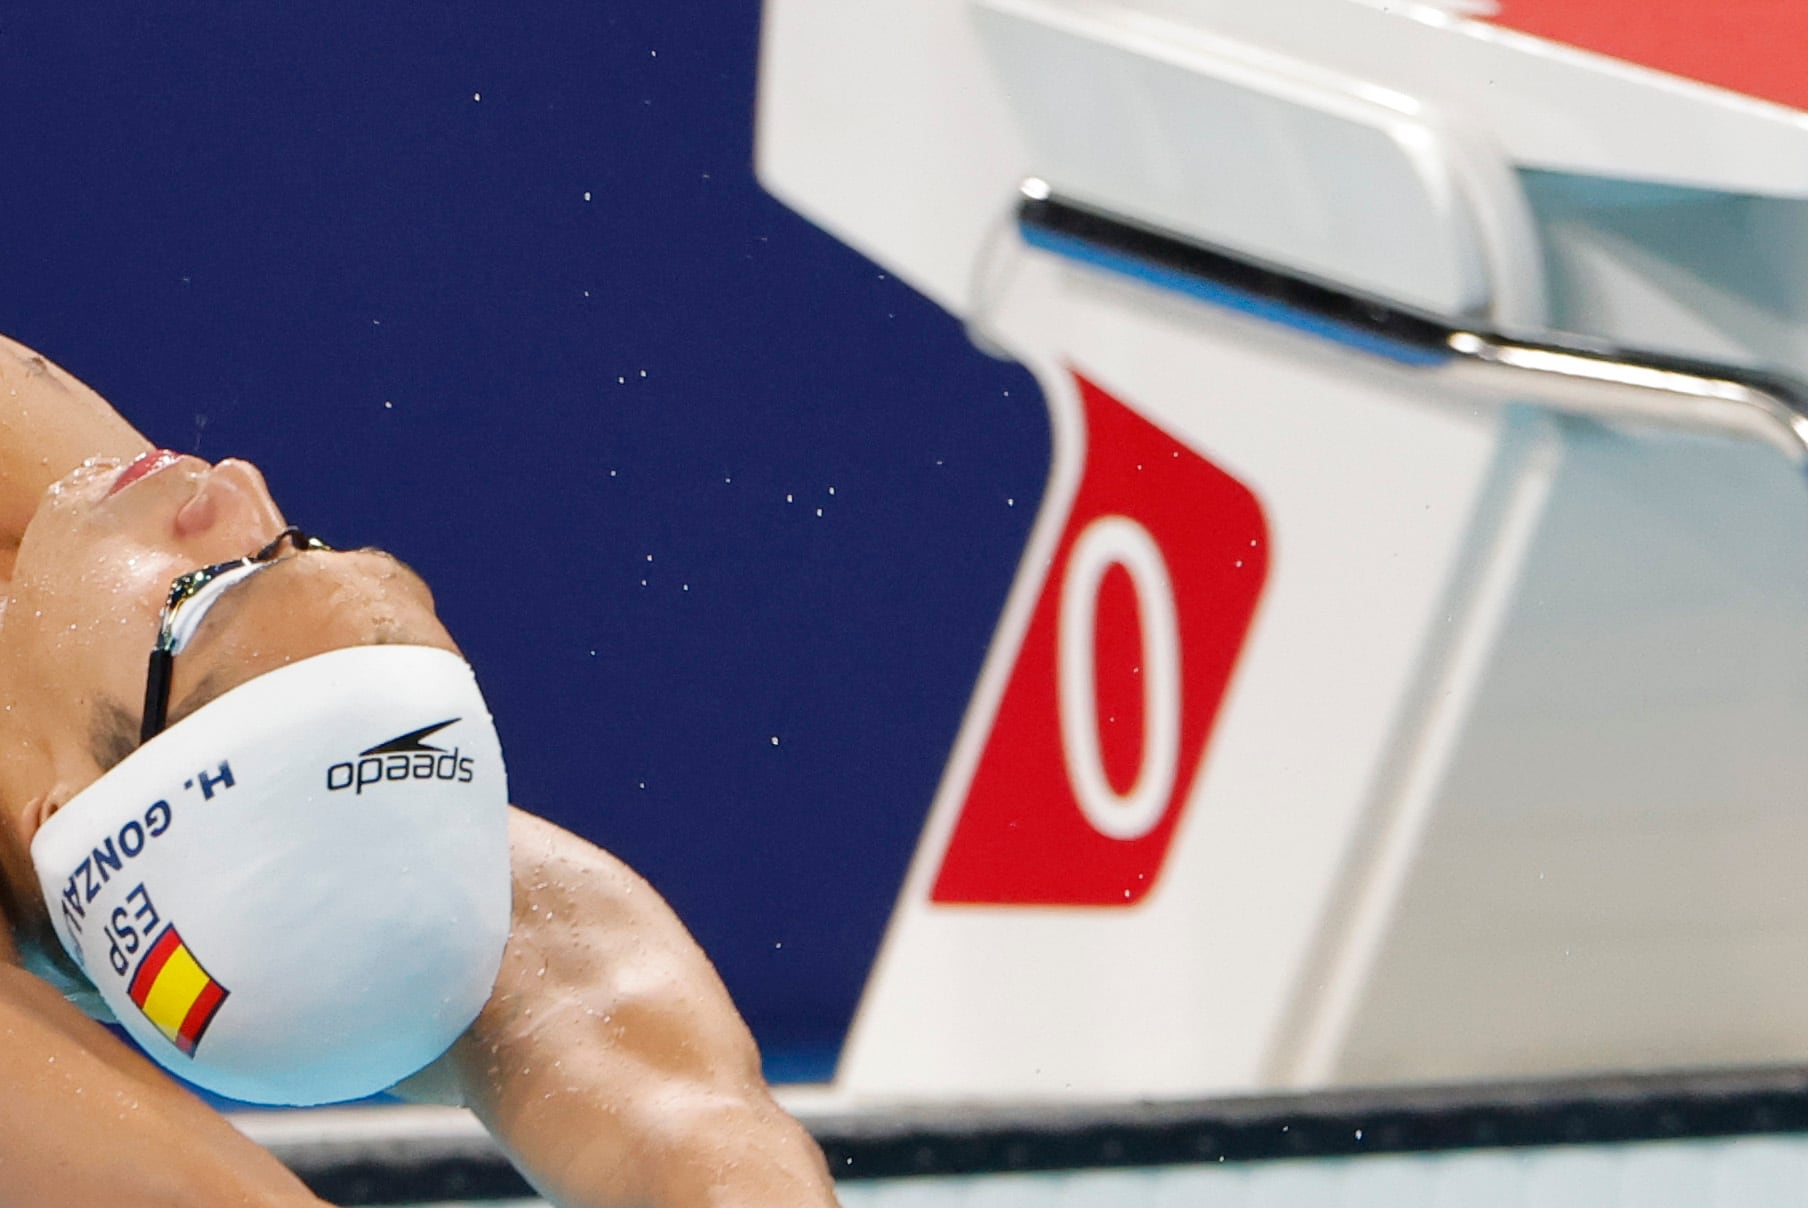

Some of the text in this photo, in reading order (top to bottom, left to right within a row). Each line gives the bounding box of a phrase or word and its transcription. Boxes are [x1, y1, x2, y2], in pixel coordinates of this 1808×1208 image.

[1057, 513, 1182, 842] 0
[327, 748, 474, 795] speedo
[61, 760, 237, 955] H. GONZAL
[104, 882, 160, 977] ESP
